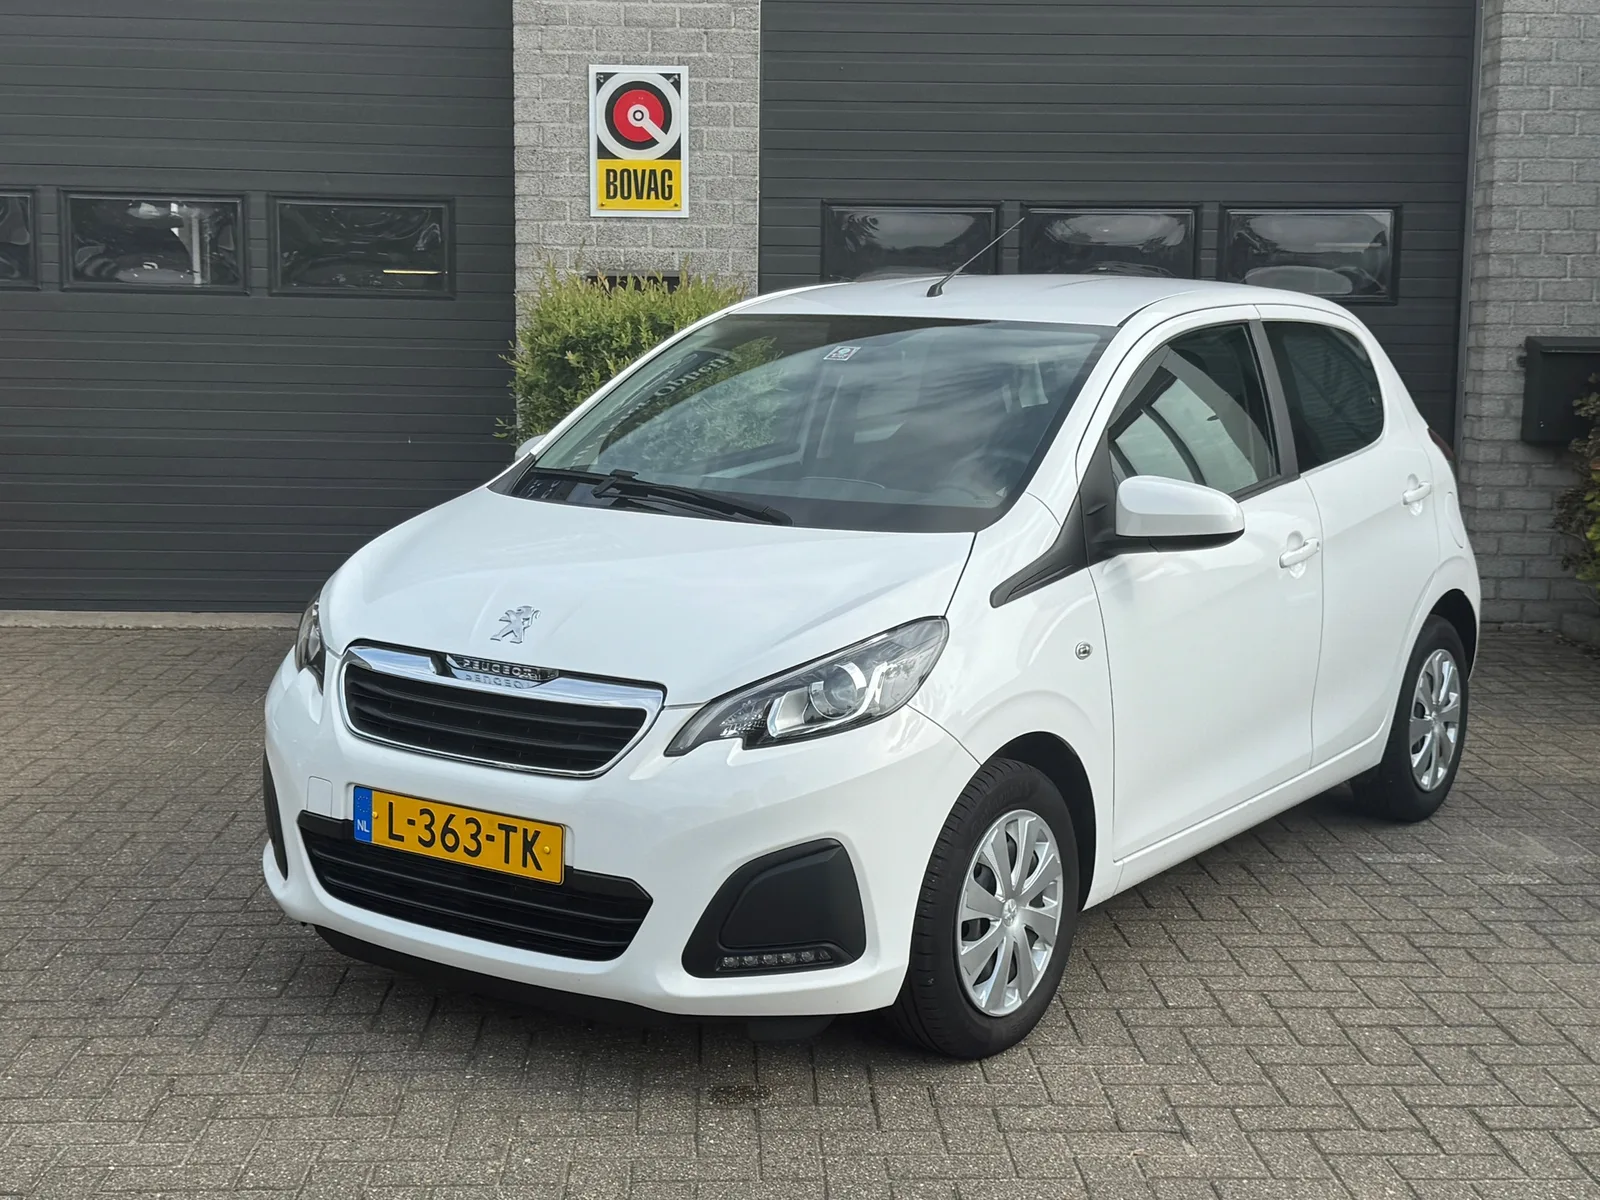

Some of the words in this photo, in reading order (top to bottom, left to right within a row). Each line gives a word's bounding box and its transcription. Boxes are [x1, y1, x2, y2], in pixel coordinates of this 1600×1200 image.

[605, 168, 673, 201] BOVAG
[356, 818, 370, 833] NL
[388, 801, 543, 872] L-363-TK
